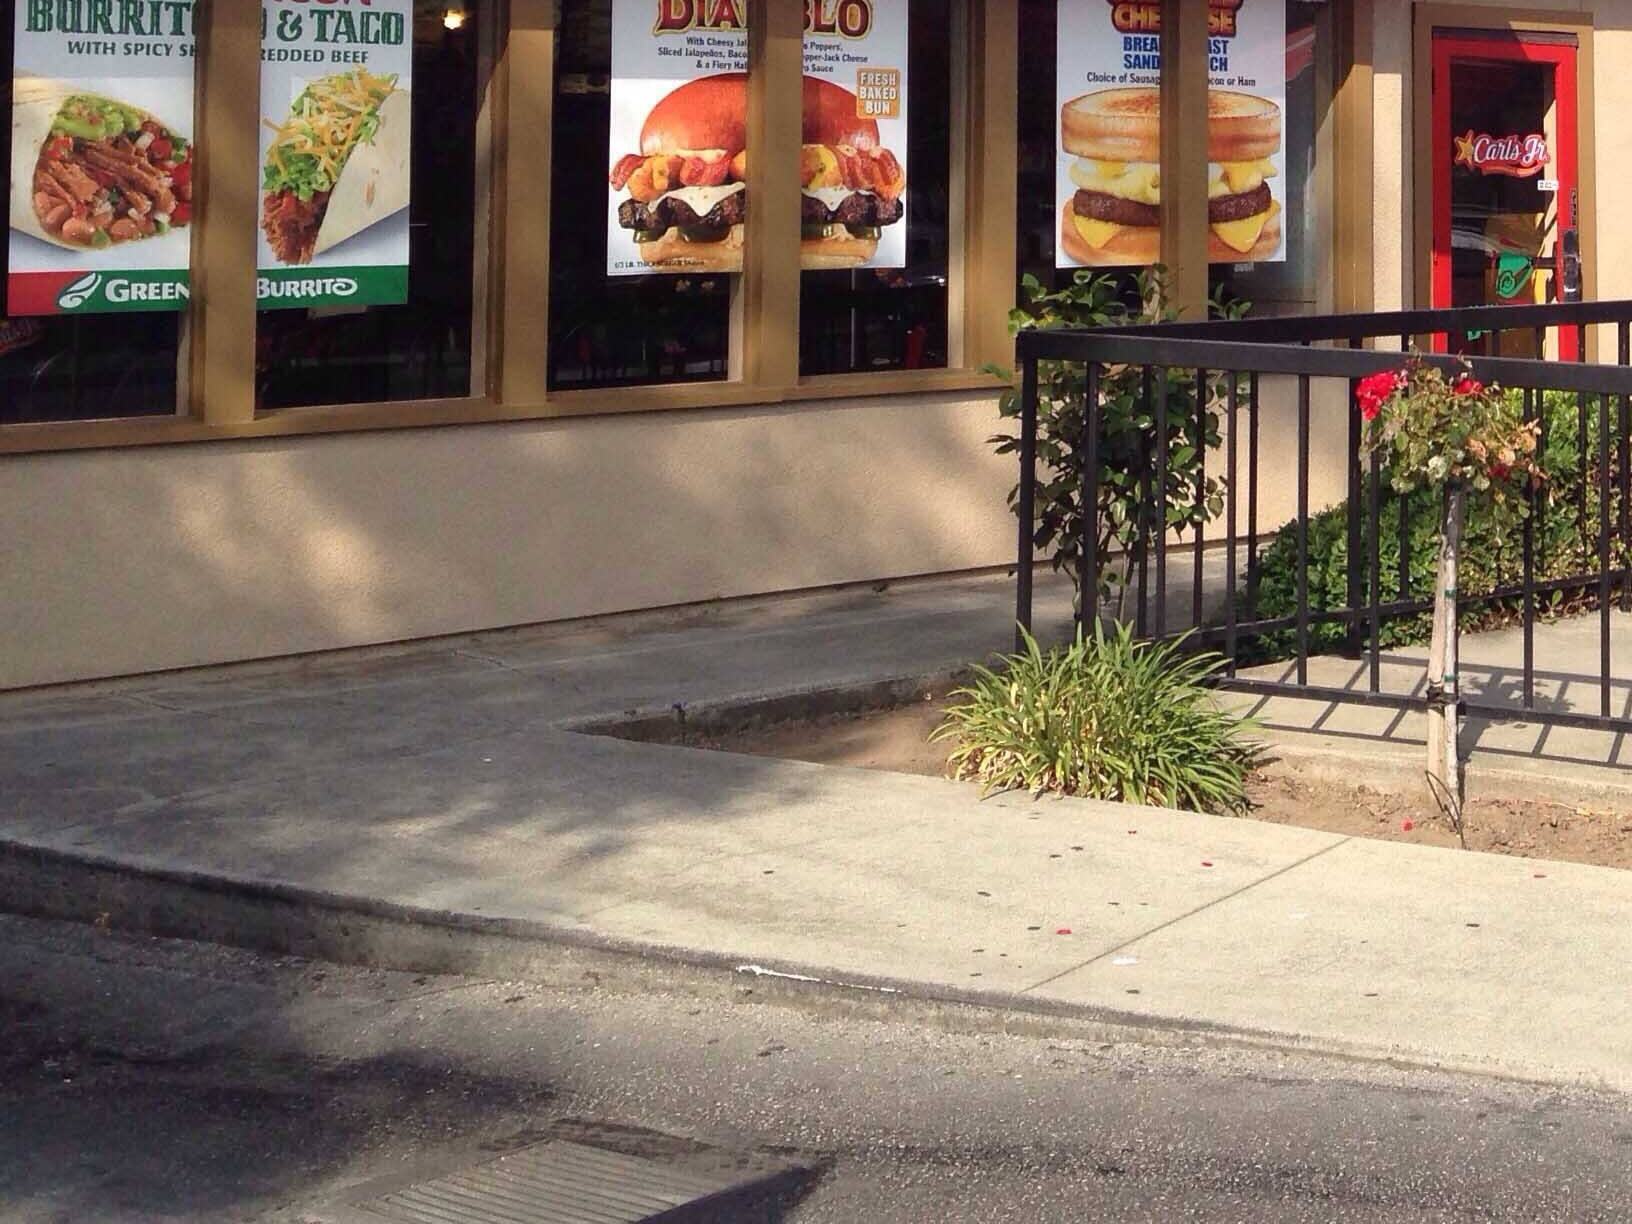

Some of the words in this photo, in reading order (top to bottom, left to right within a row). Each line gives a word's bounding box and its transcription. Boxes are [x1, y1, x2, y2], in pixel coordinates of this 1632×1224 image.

[276, 9, 303, 42] &
[309, 9, 404, 45] TACO
[67, 41, 116, 56] WITH
[123, 43, 173, 57] SPICY
[331, 50, 368, 64] BEEF
[860, 72, 896, 86] FRESH
[1086, 72, 1118, 83] Choice
[1119, 72, 1128, 83] of
[1237, 76, 1257, 87] Ham
[859, 86, 897, 101] BAKED
[865, 100, 890, 115] BUN
